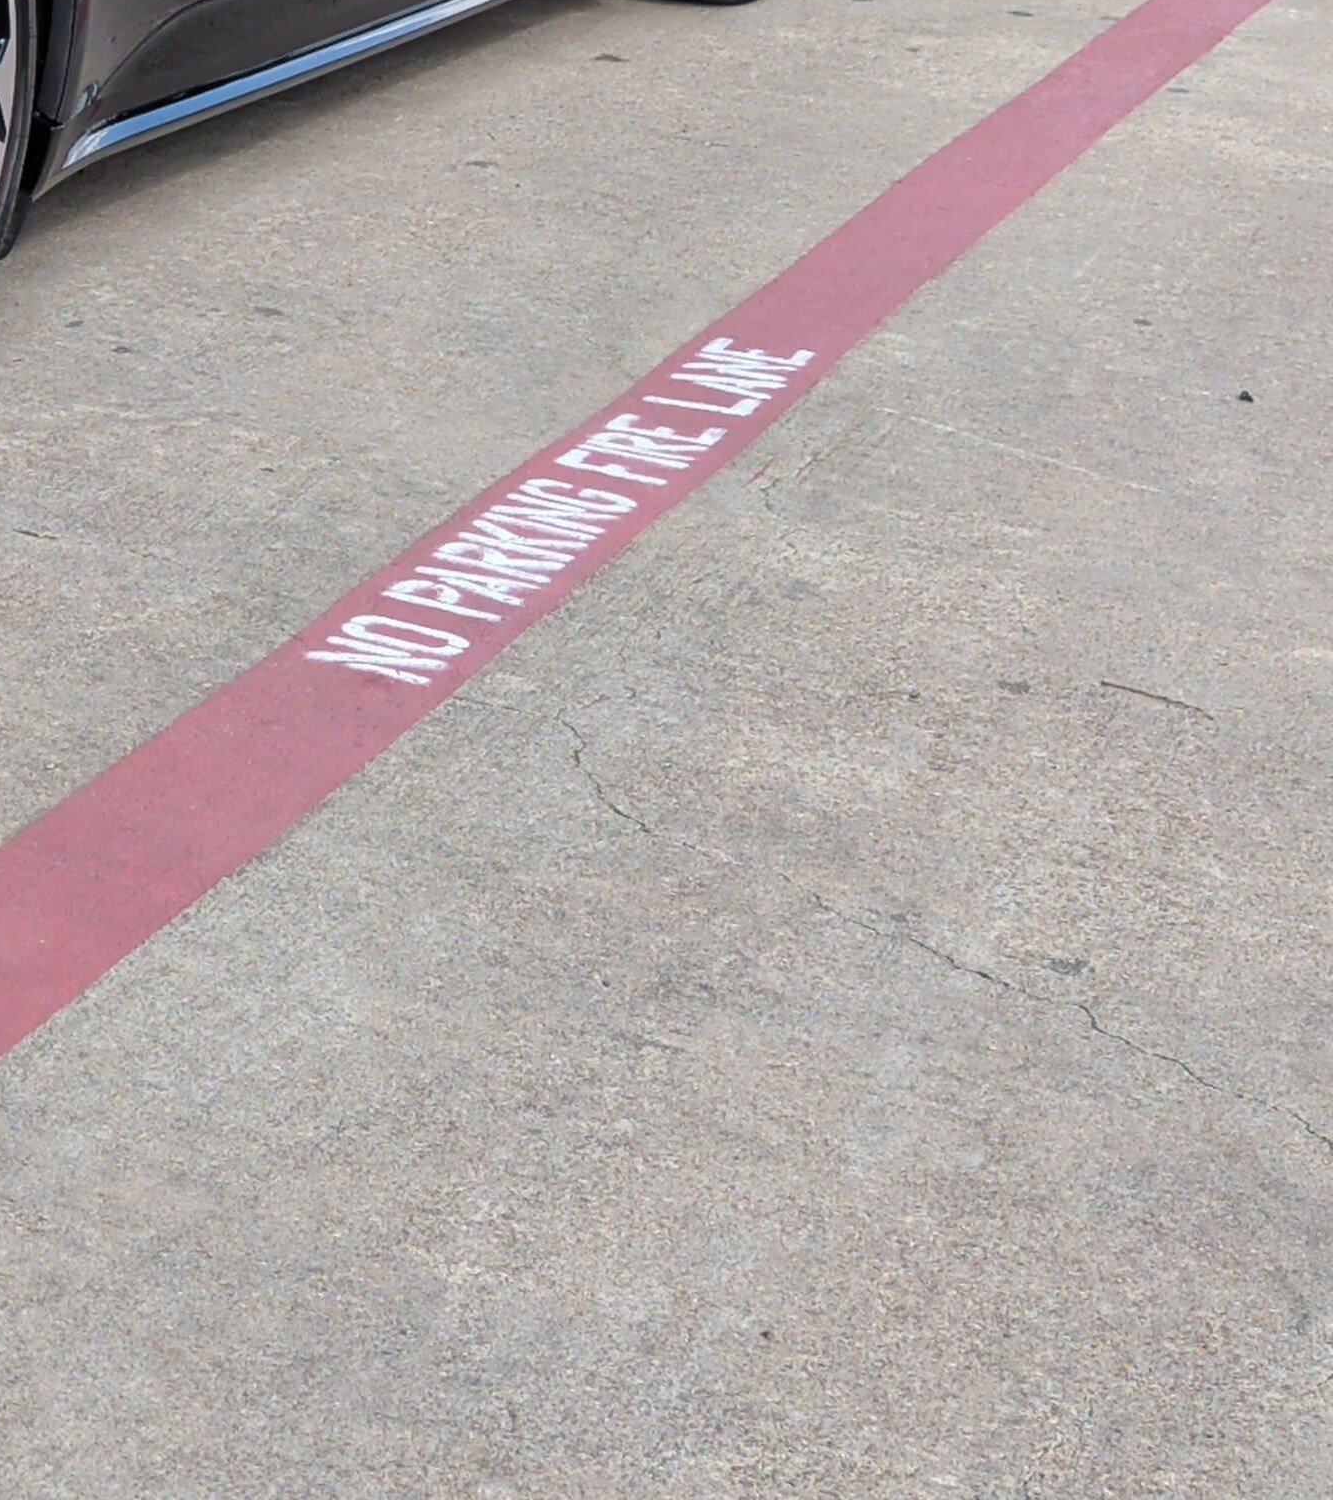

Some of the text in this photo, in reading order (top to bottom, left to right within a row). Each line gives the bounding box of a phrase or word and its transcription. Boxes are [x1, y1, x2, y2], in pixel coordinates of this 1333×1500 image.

[304, 337, 816, 686] NO PARKING FIRE LANE
